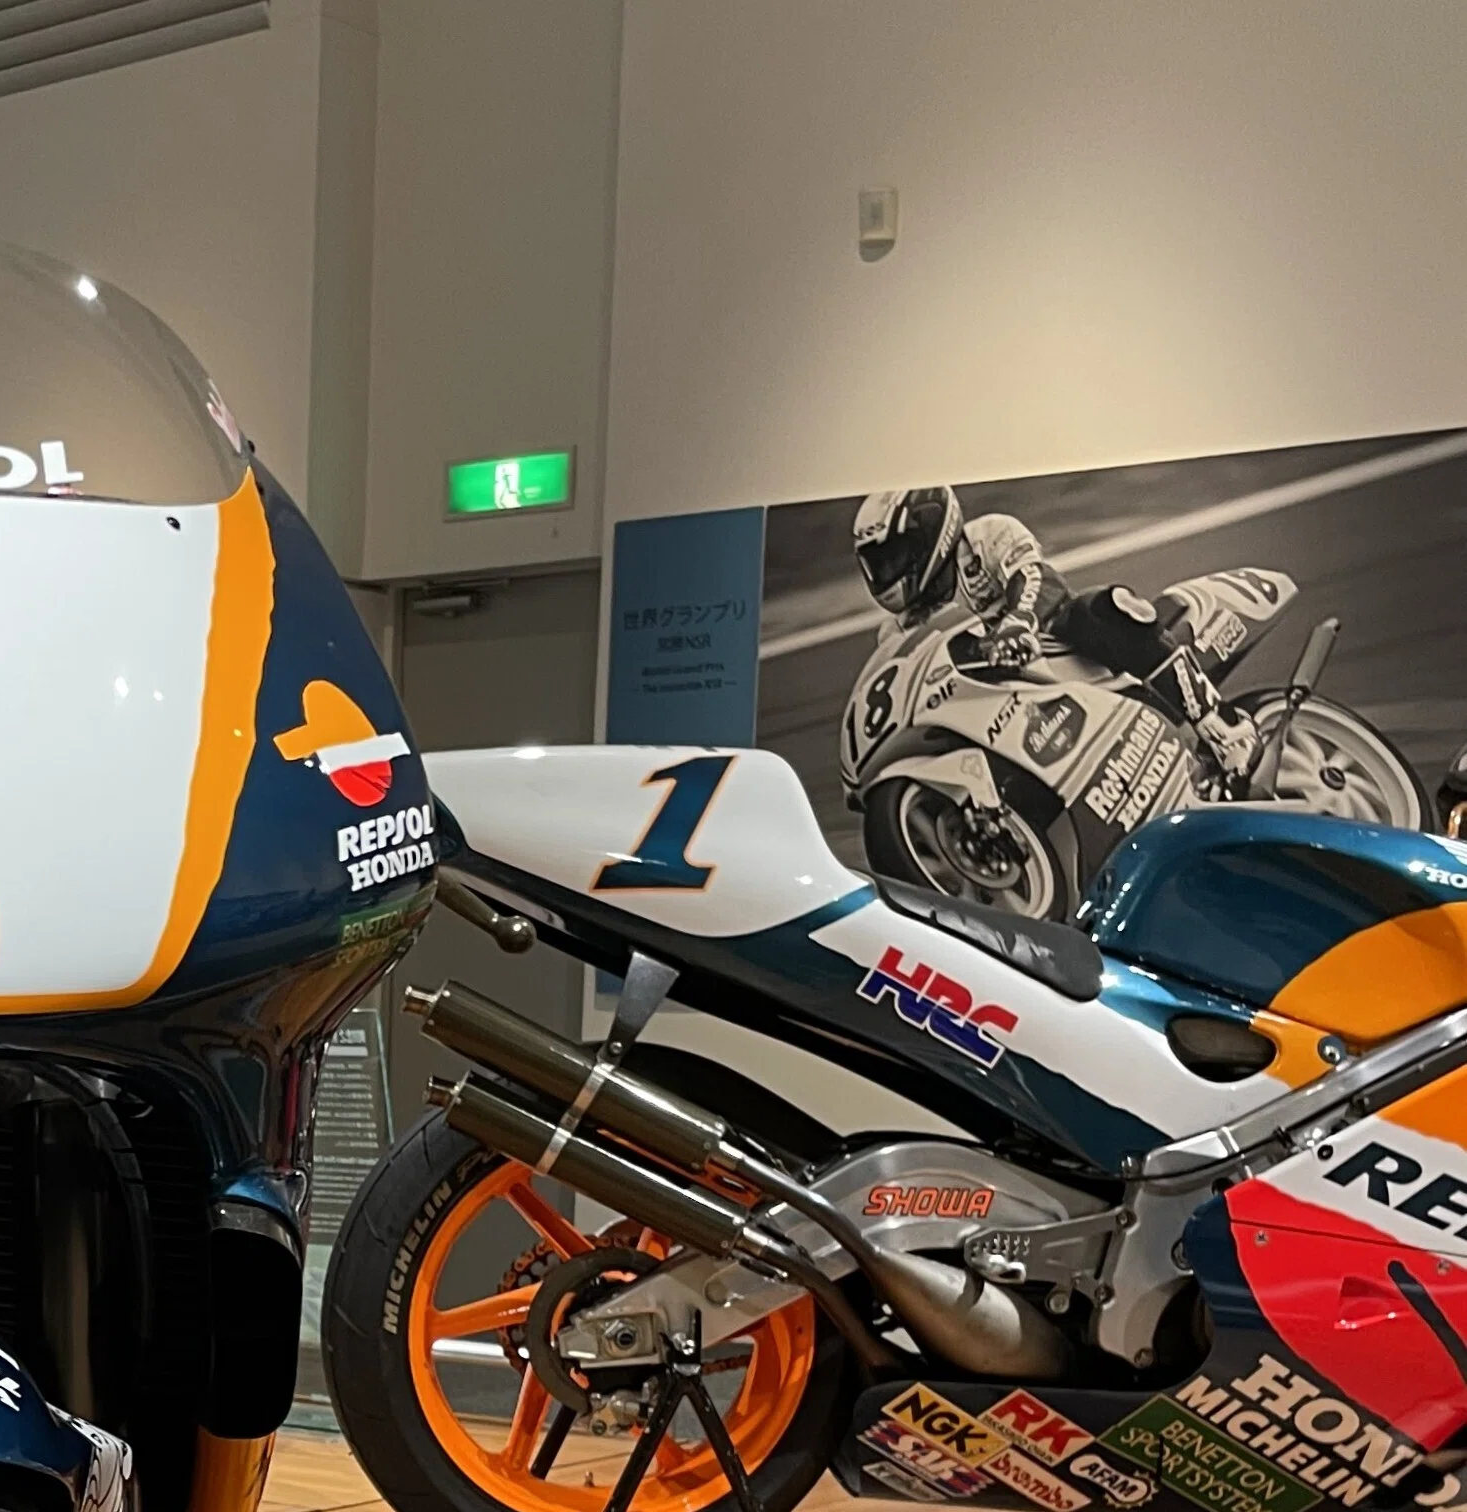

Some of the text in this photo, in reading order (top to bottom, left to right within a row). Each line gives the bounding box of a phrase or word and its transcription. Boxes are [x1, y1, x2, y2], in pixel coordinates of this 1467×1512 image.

[1084, 709, 1162, 823] Rothmans
[1116, 737, 1179, 833] HONDA
[337, 804, 434, 862] REPSOL
[589, 754, 740, 894] 1
[347, 841, 434, 892] HONDA
[856, 945, 1020, 1070] HRC
[862, 1185, 995, 1218] SHOWA
[1322, 1141, 1467, 1241] RE
[382, 1181, 453, 1335] MICHELIN
[892, 1391, 988, 1455] NGK
[991, 1393, 1090, 1458] RK
[1161, 1419, 1286, 1501] BENETTON
[1175, 1375, 1376, 1508] MICHELIN
[989, 1453, 1074, 1510] brembo
[1079, 1461, 1138, 1497] AFAM
